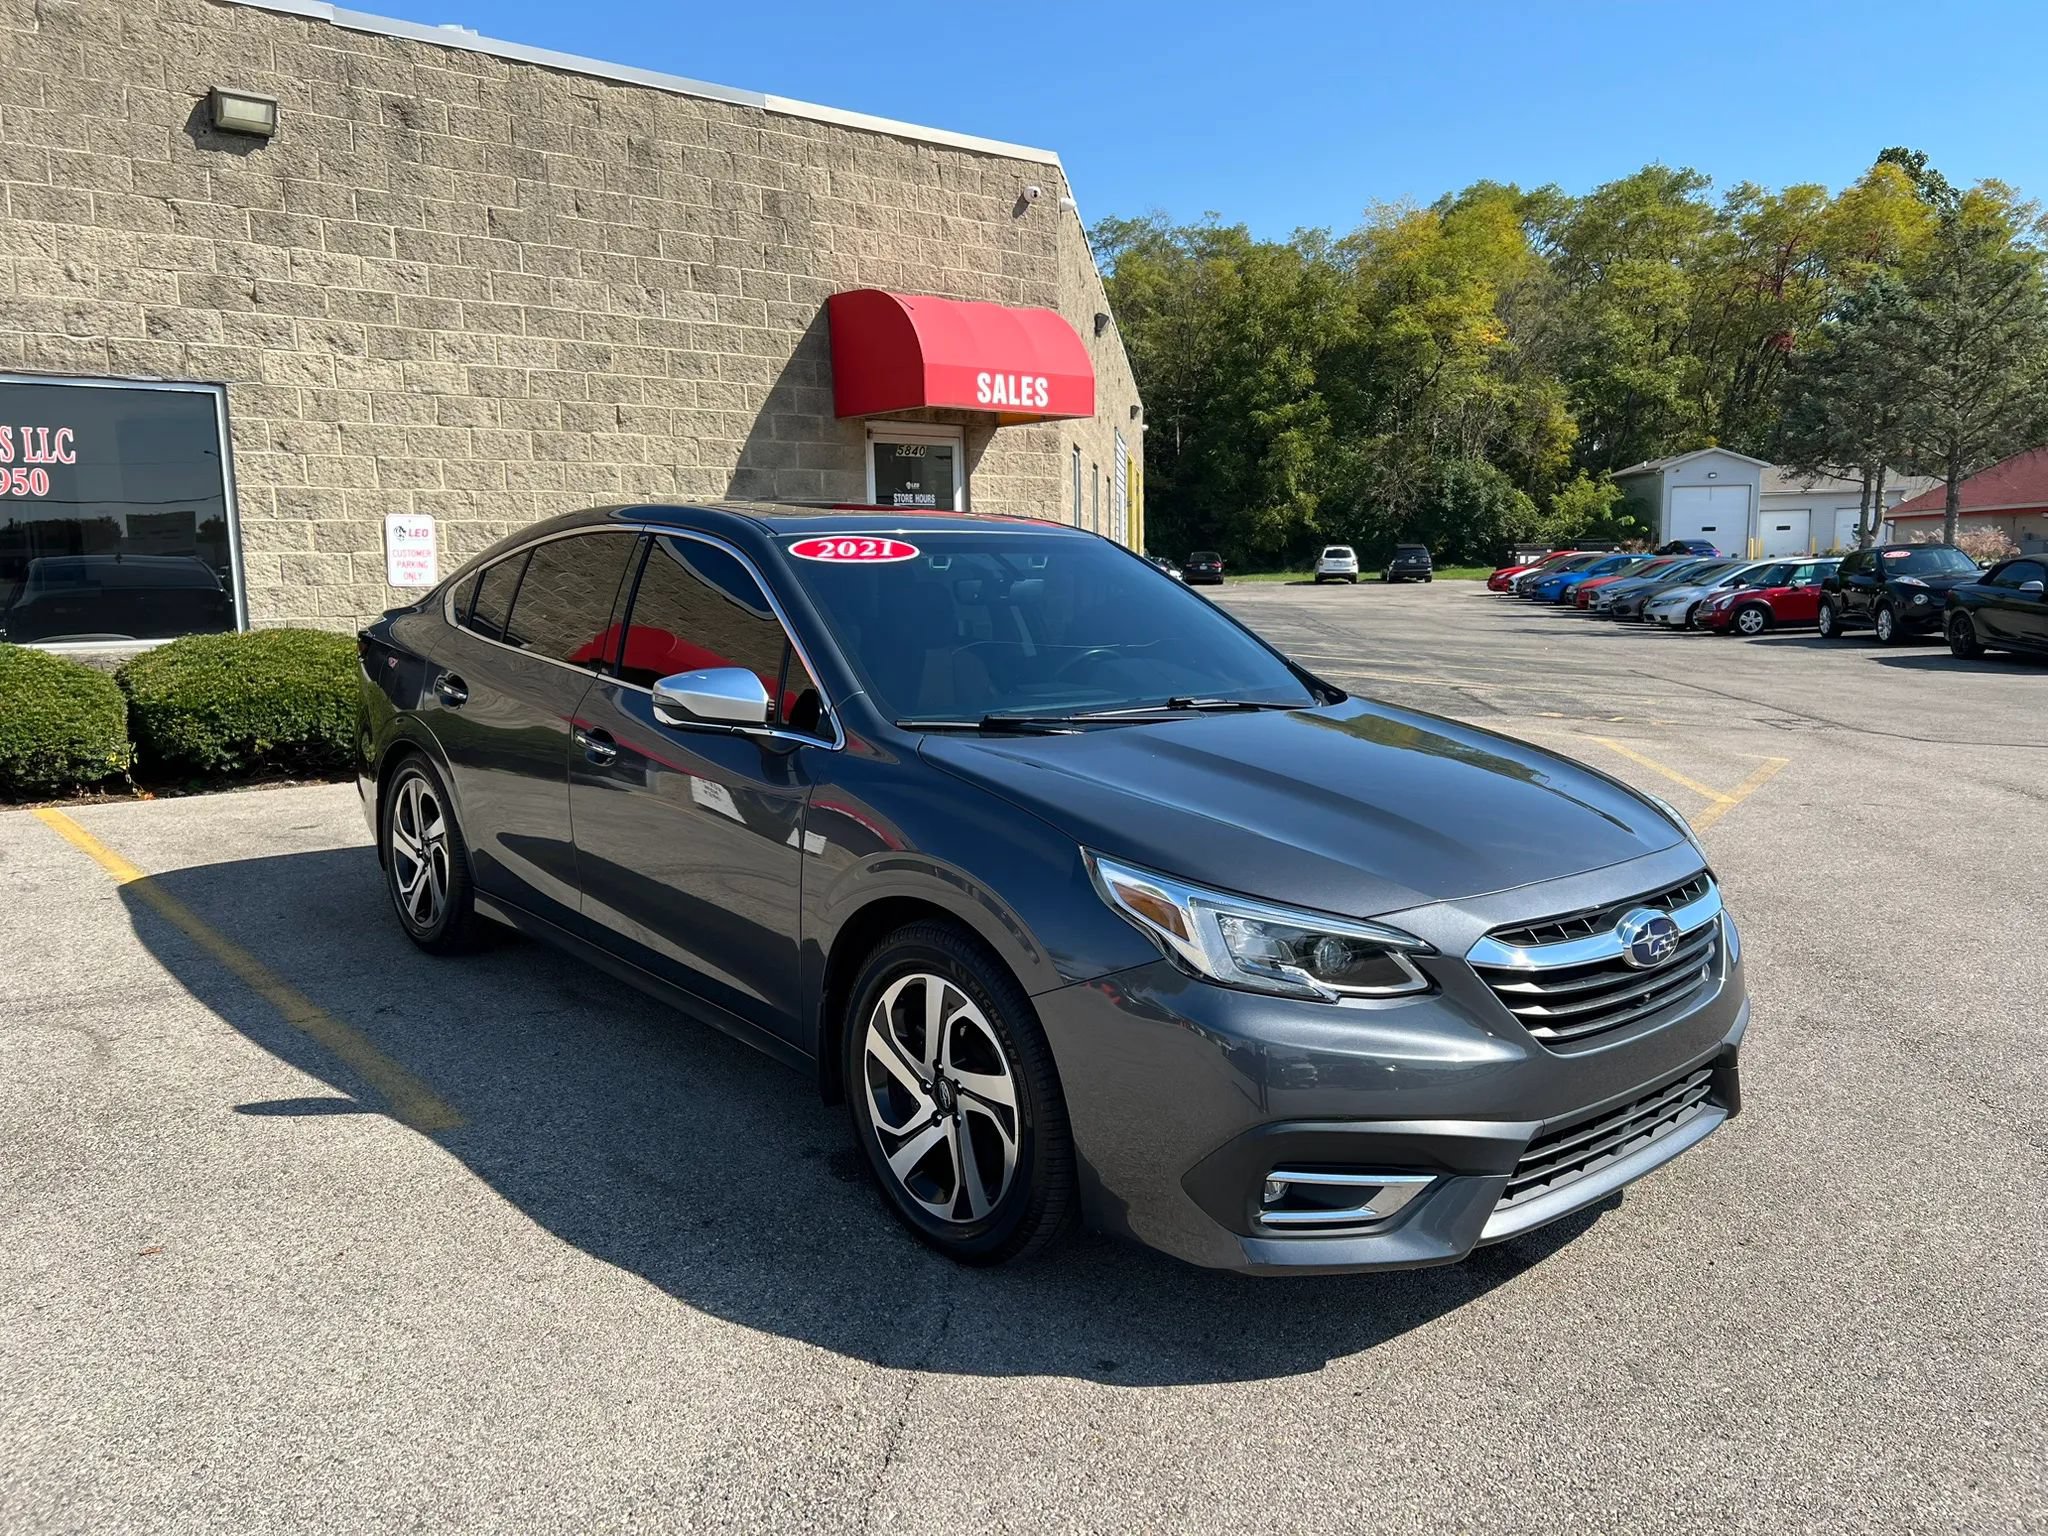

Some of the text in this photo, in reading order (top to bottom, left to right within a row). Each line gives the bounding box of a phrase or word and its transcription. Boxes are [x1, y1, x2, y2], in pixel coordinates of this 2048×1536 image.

[976, 371, 1049, 408] SALES
[21, 427, 76, 464] LLC
[897, 445, 926, 457] 5840
[893, 493, 936, 504] STORE HOURS
[409, 528, 428, 537] LEO
[392, 549, 431, 558] CUSTOMER
[816, 540, 894, 558] 2021
[397, 560, 428, 568] PARKING
[403, 572, 422, 580] ONLY
[969, 981, 1017, 1062] MICHELIN
